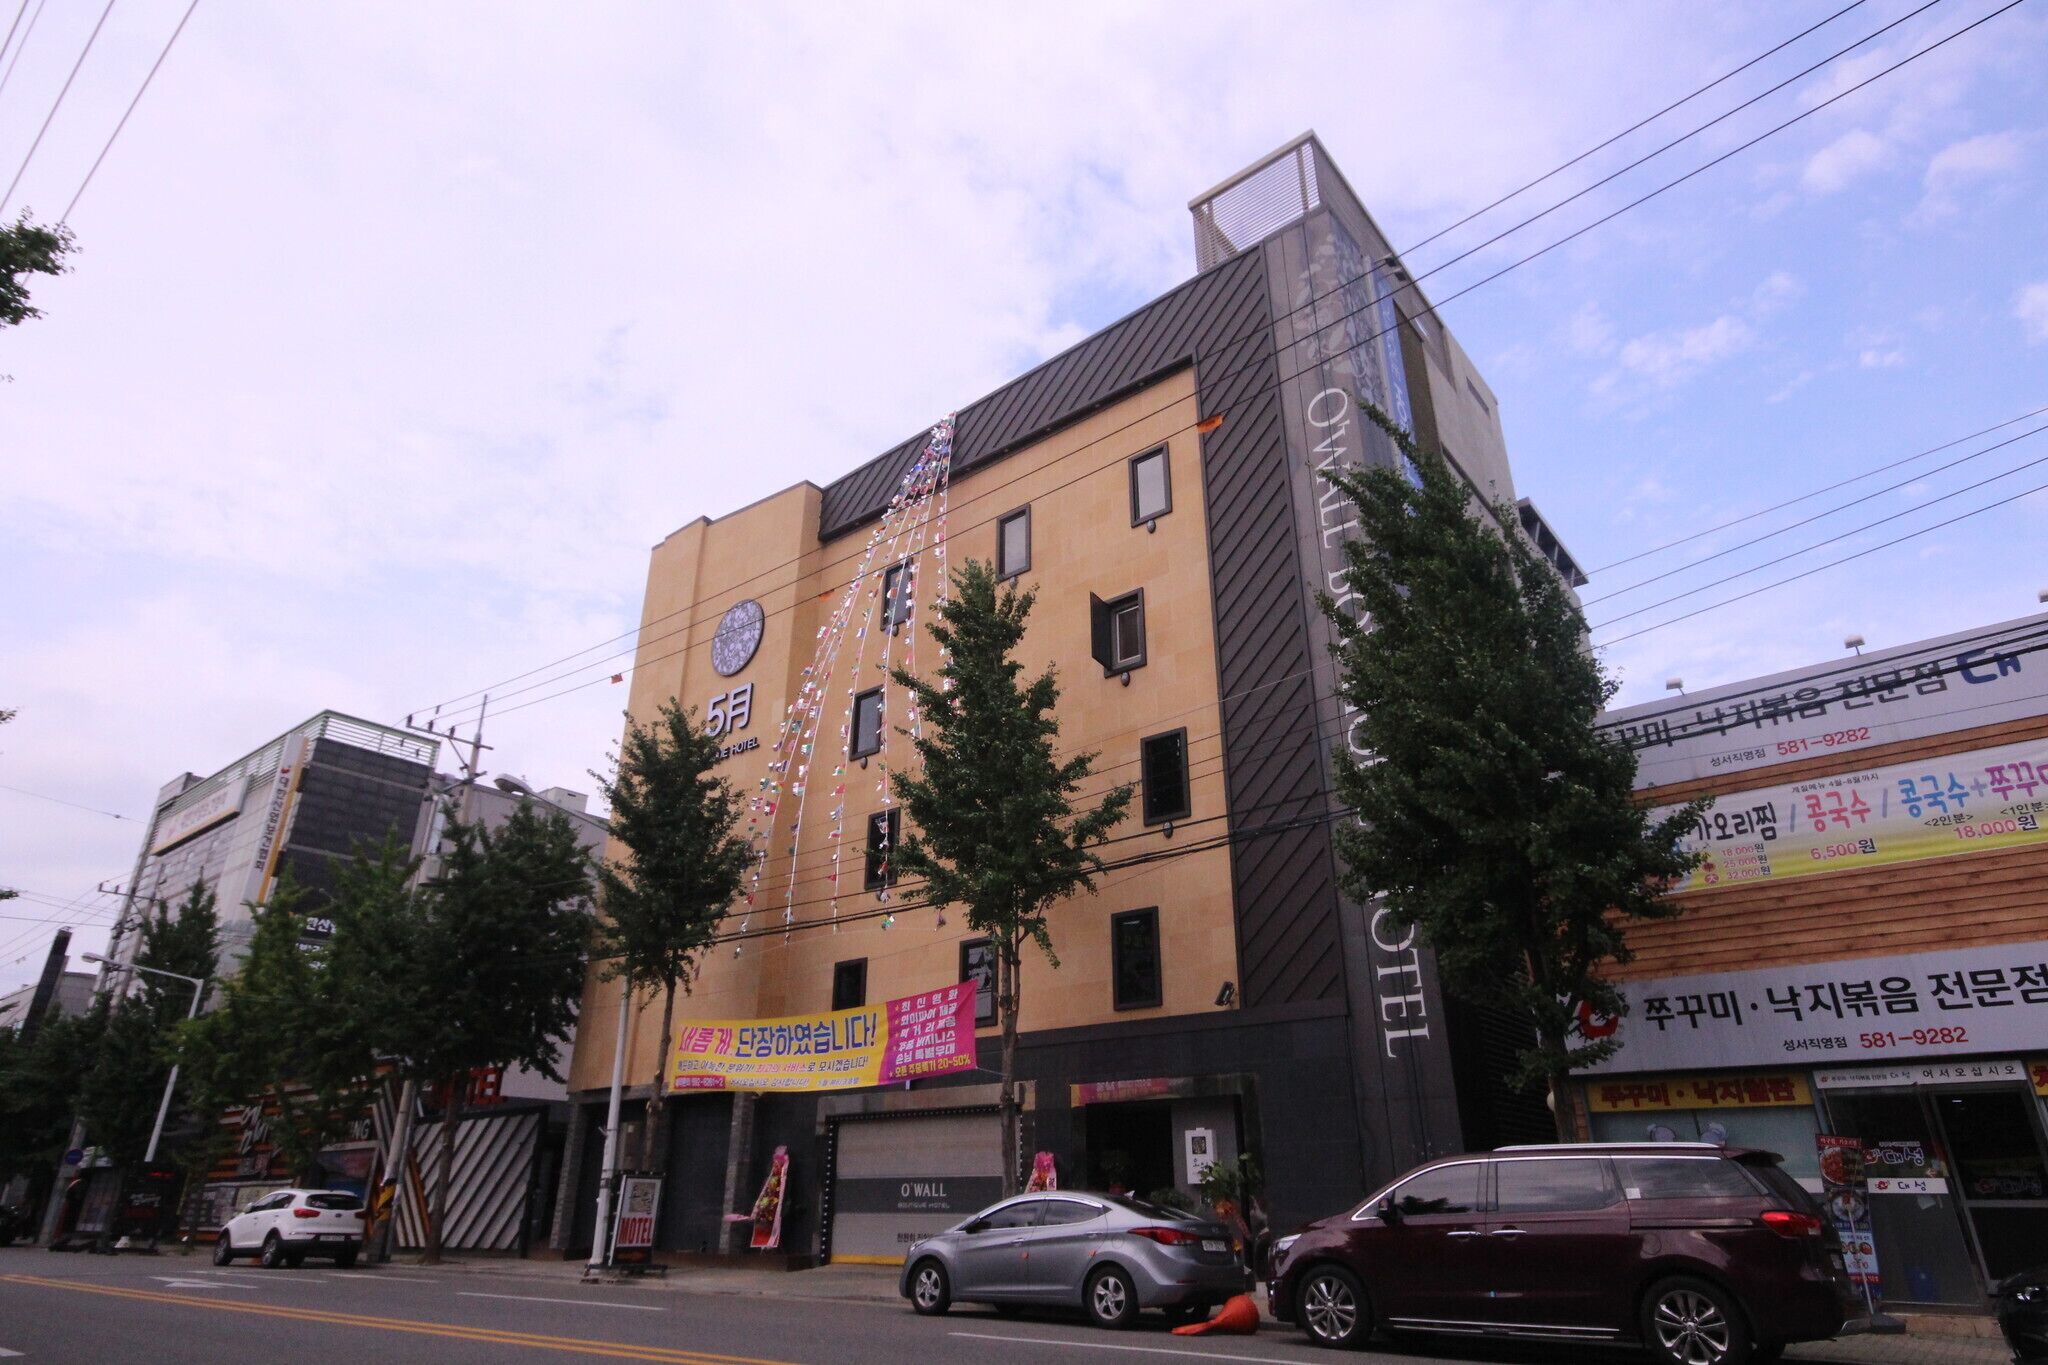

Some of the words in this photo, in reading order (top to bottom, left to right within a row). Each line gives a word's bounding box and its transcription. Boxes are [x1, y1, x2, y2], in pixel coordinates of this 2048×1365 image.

[1836, 660, 1948, 710] 전문점
[704, 682, 754, 738] 5月
[731, 736, 760, 756] HOTEL
[1710, 748, 1767, 767] 성서직영점
[1776, 727, 1871, 756] 581-9282
[1804, 788, 1872, 833] 콩국수
[1953, 814, 2039, 839] 18,000원
[1810, 838, 1878, 861] 6,500원
[1644, 990, 1743, 1031] 쭈꾸미
[1766, 976, 1920, 1021] 낙지볶음
[1928, 963, 2048, 1011] 전문점
[735, 1013, 877, 1058] 단장하였습니다!
[1783, 1036, 1847, 1051] 성서직영점
[1860, 1027, 1969, 1049] 581-9282
[901, 1182, 947, 1197] O'WALL
[618, 1217, 653, 1244] MOTEL
